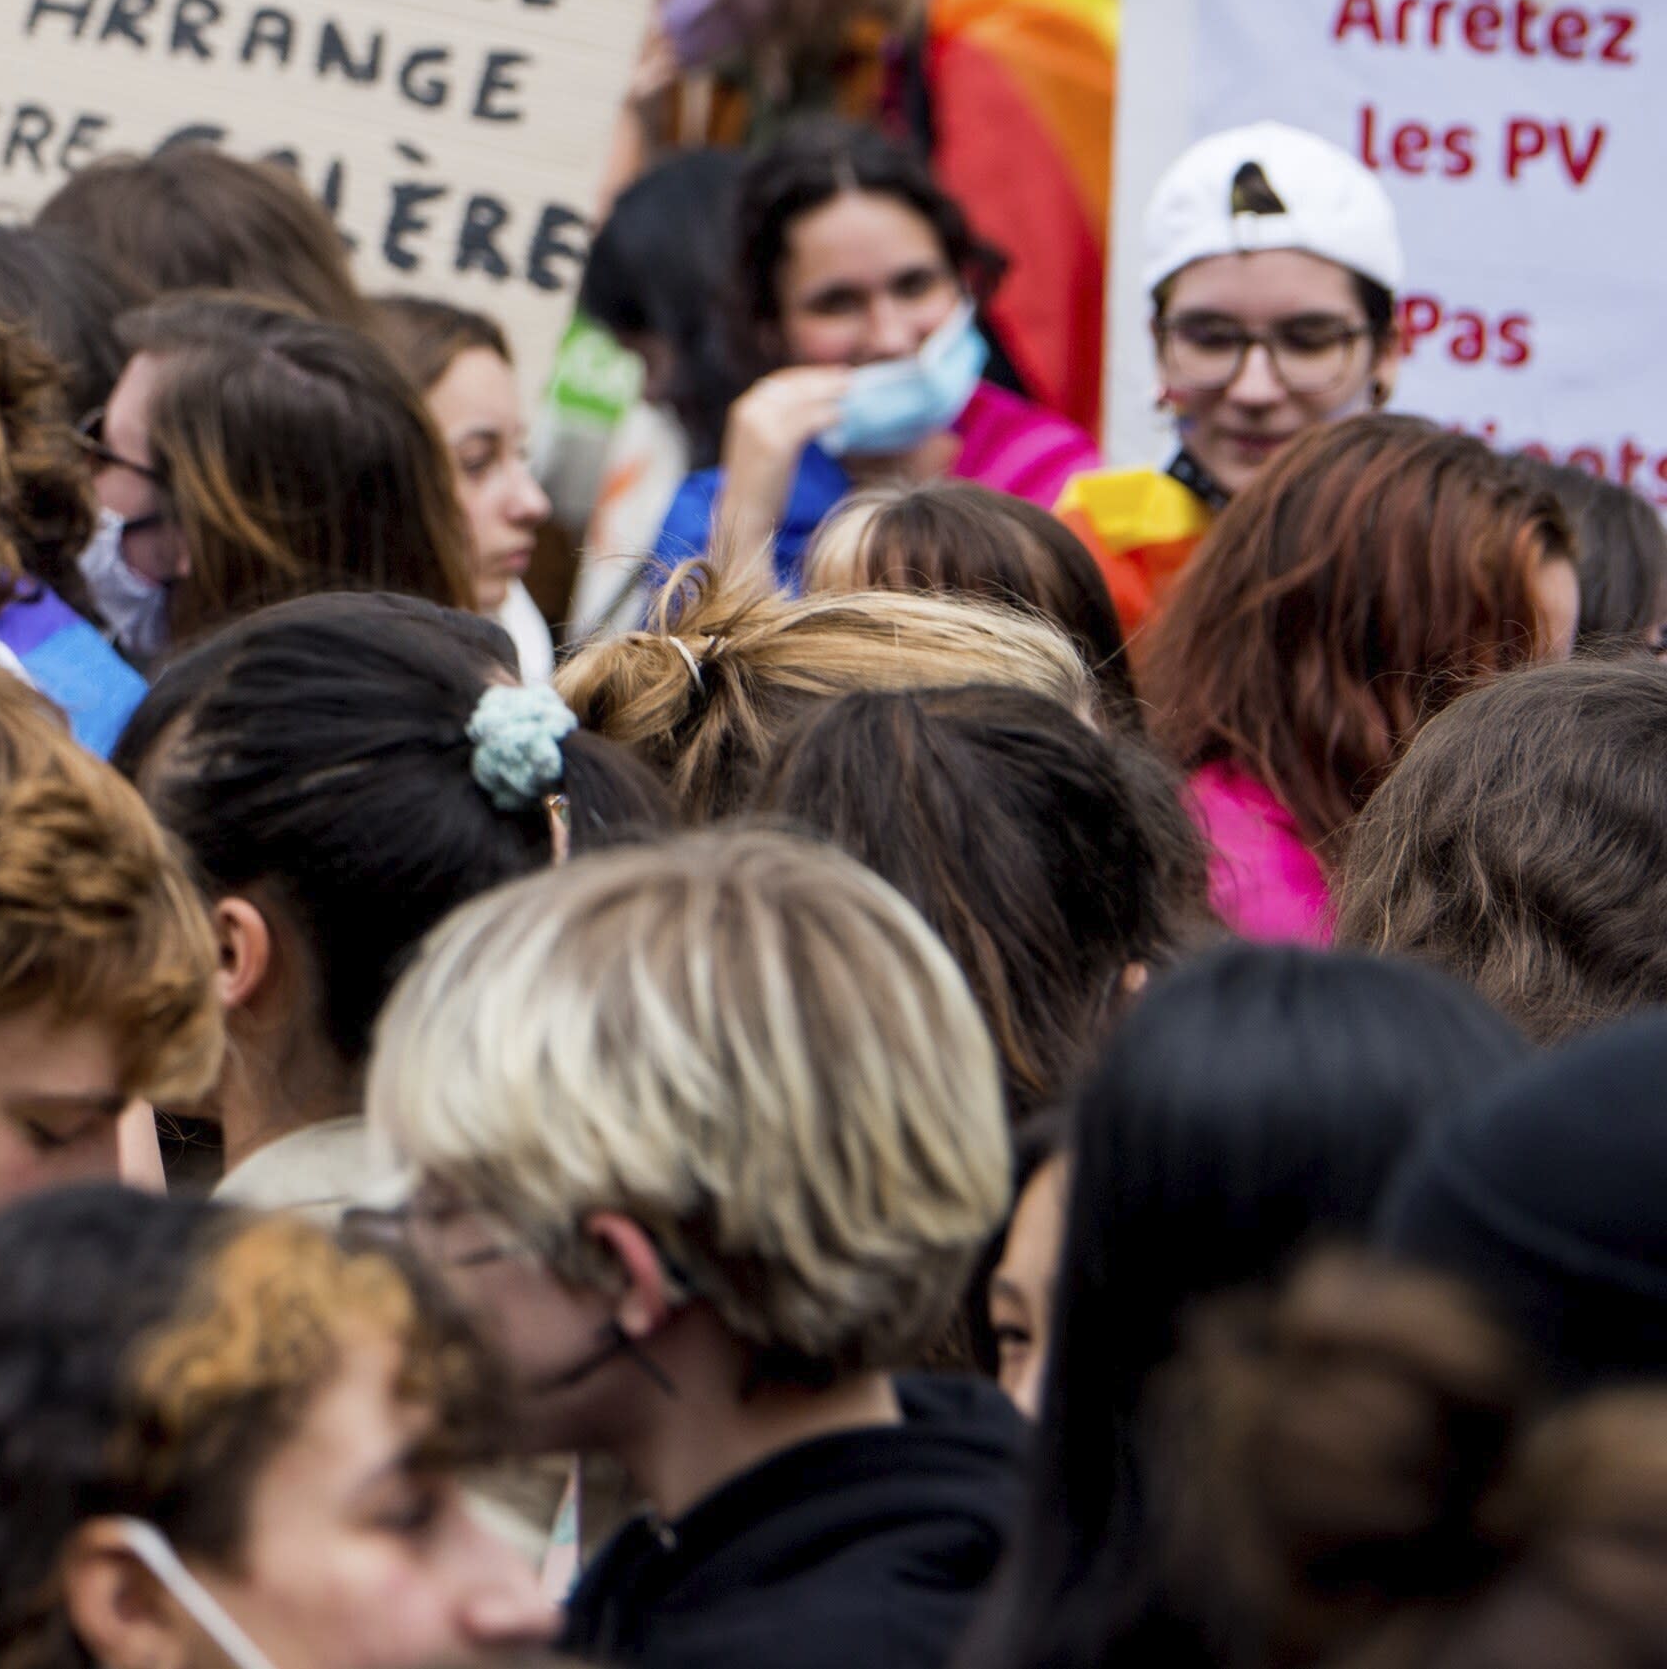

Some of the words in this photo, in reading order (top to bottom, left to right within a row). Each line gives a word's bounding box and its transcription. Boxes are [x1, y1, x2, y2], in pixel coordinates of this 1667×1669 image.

[1360, 106, 1476, 179] les
[1503, 118, 1606, 187] PV
[152, 124, 597, 292] LÈRE
[1401, 294, 1532, 368] Pas
